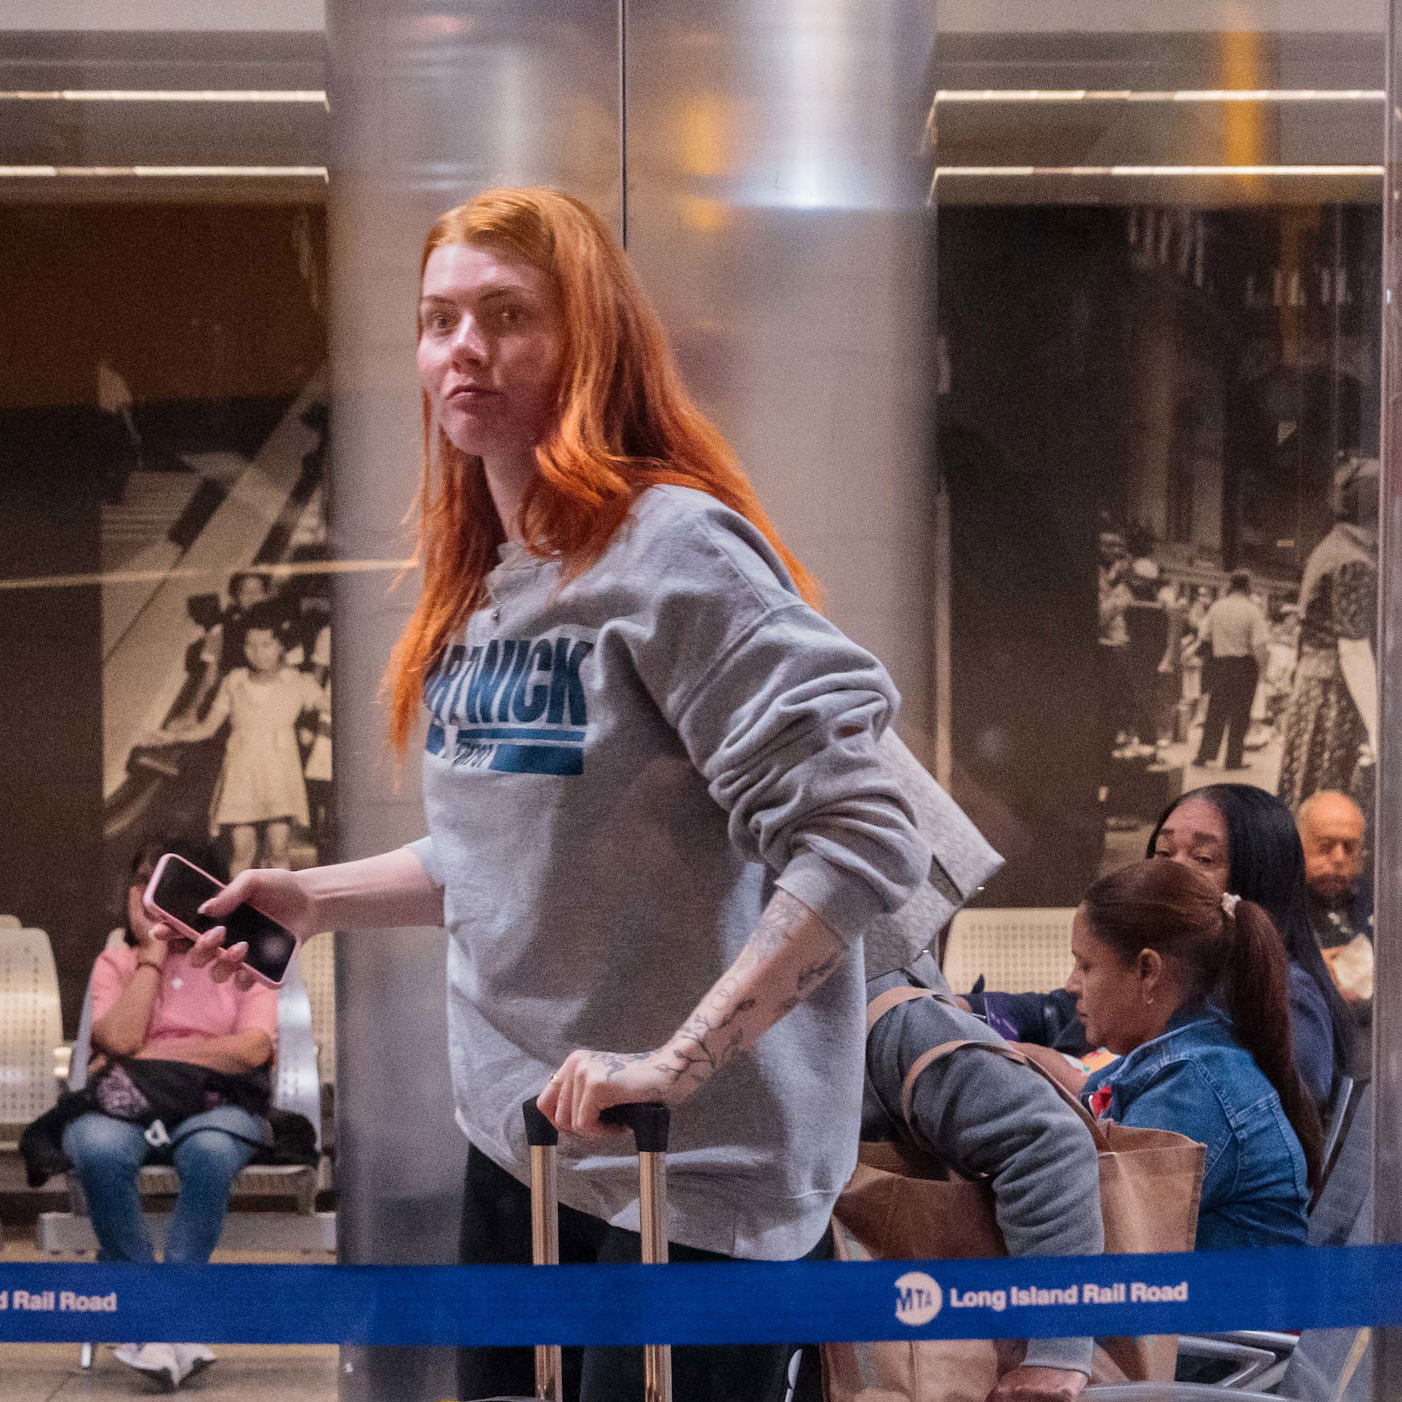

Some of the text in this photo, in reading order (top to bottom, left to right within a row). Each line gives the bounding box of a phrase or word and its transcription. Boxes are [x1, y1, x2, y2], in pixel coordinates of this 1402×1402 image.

[12, 1289, 55, 1311] Rail
[59, 1290, 117, 1312] Road
[950, 1287, 1007, 1312] Long
[1010, 1285, 1078, 1306] Island
[1082, 1282, 1126, 1303] Rail
[1130, 1281, 1188, 1302] Road
